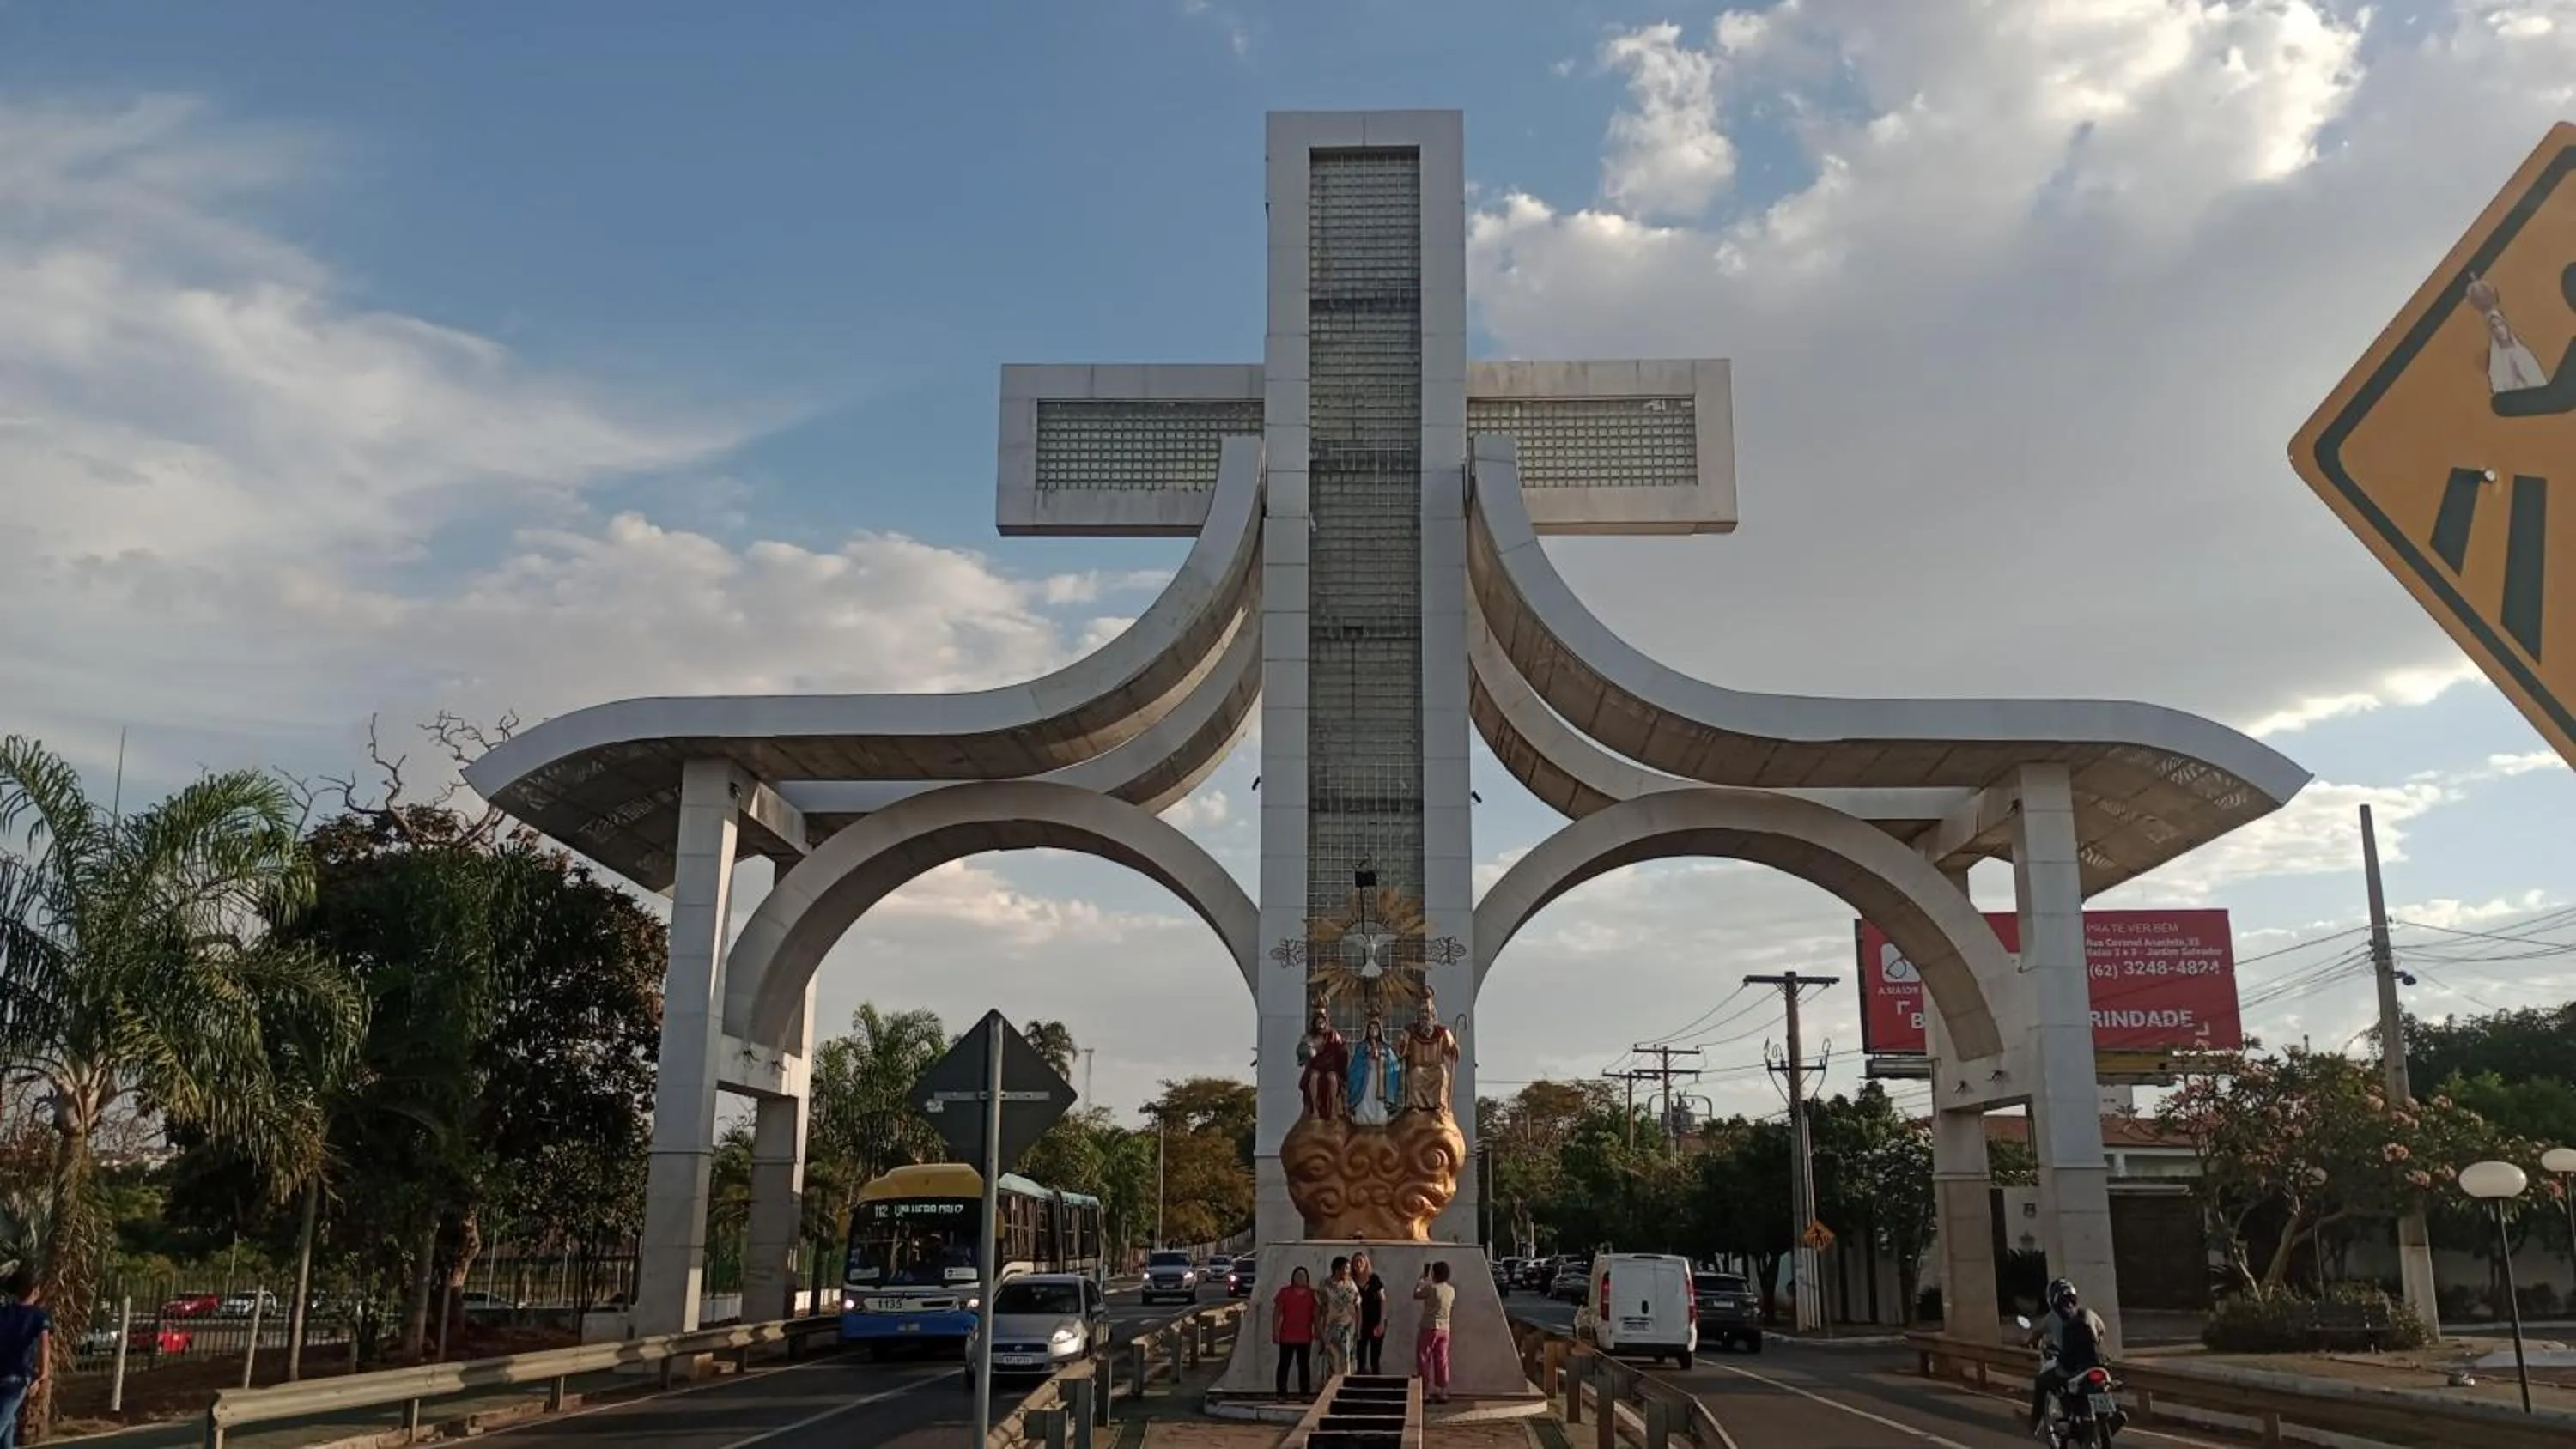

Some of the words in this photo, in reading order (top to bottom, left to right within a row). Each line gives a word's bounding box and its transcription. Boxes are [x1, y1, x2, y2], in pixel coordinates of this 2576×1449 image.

[2112, 923, 2126, 933] TE
[2128, 923, 2152, 933] VER
[2089, 963, 2118, 979] (62)
[2088, 1010, 2195, 1028] RINDADE
